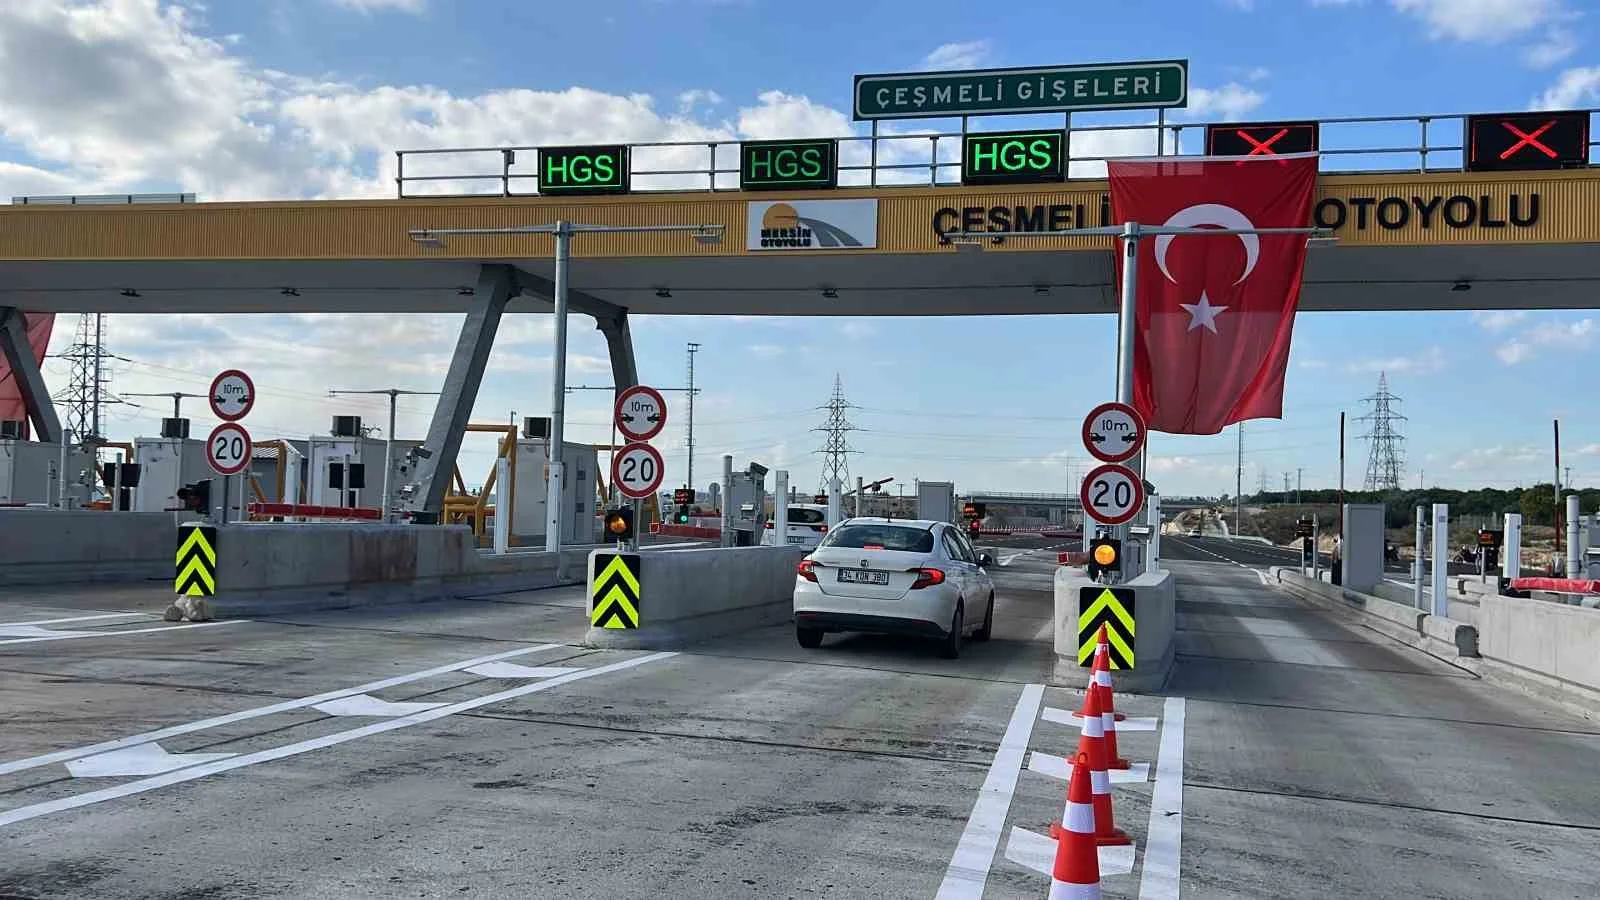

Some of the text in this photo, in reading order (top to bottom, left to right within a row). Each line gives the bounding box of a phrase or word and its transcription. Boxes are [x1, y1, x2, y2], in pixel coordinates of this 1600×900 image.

[876, 71, 1161, 109] ÇEŞMELİ GİŞELERİ
[547, 154, 614, 184] HGS
[751, 149, 822, 179] HGS
[974, 139, 1052, 171] HGS
[1313, 193, 1540, 231] OTOYOLU
[761, 227, 812, 238] MERSİN
[761, 238, 812, 248] OTOYOLU
[215, 436, 243, 460] 20
[623, 457, 654, 482] 20
[1093, 480, 1131, 508] 20
